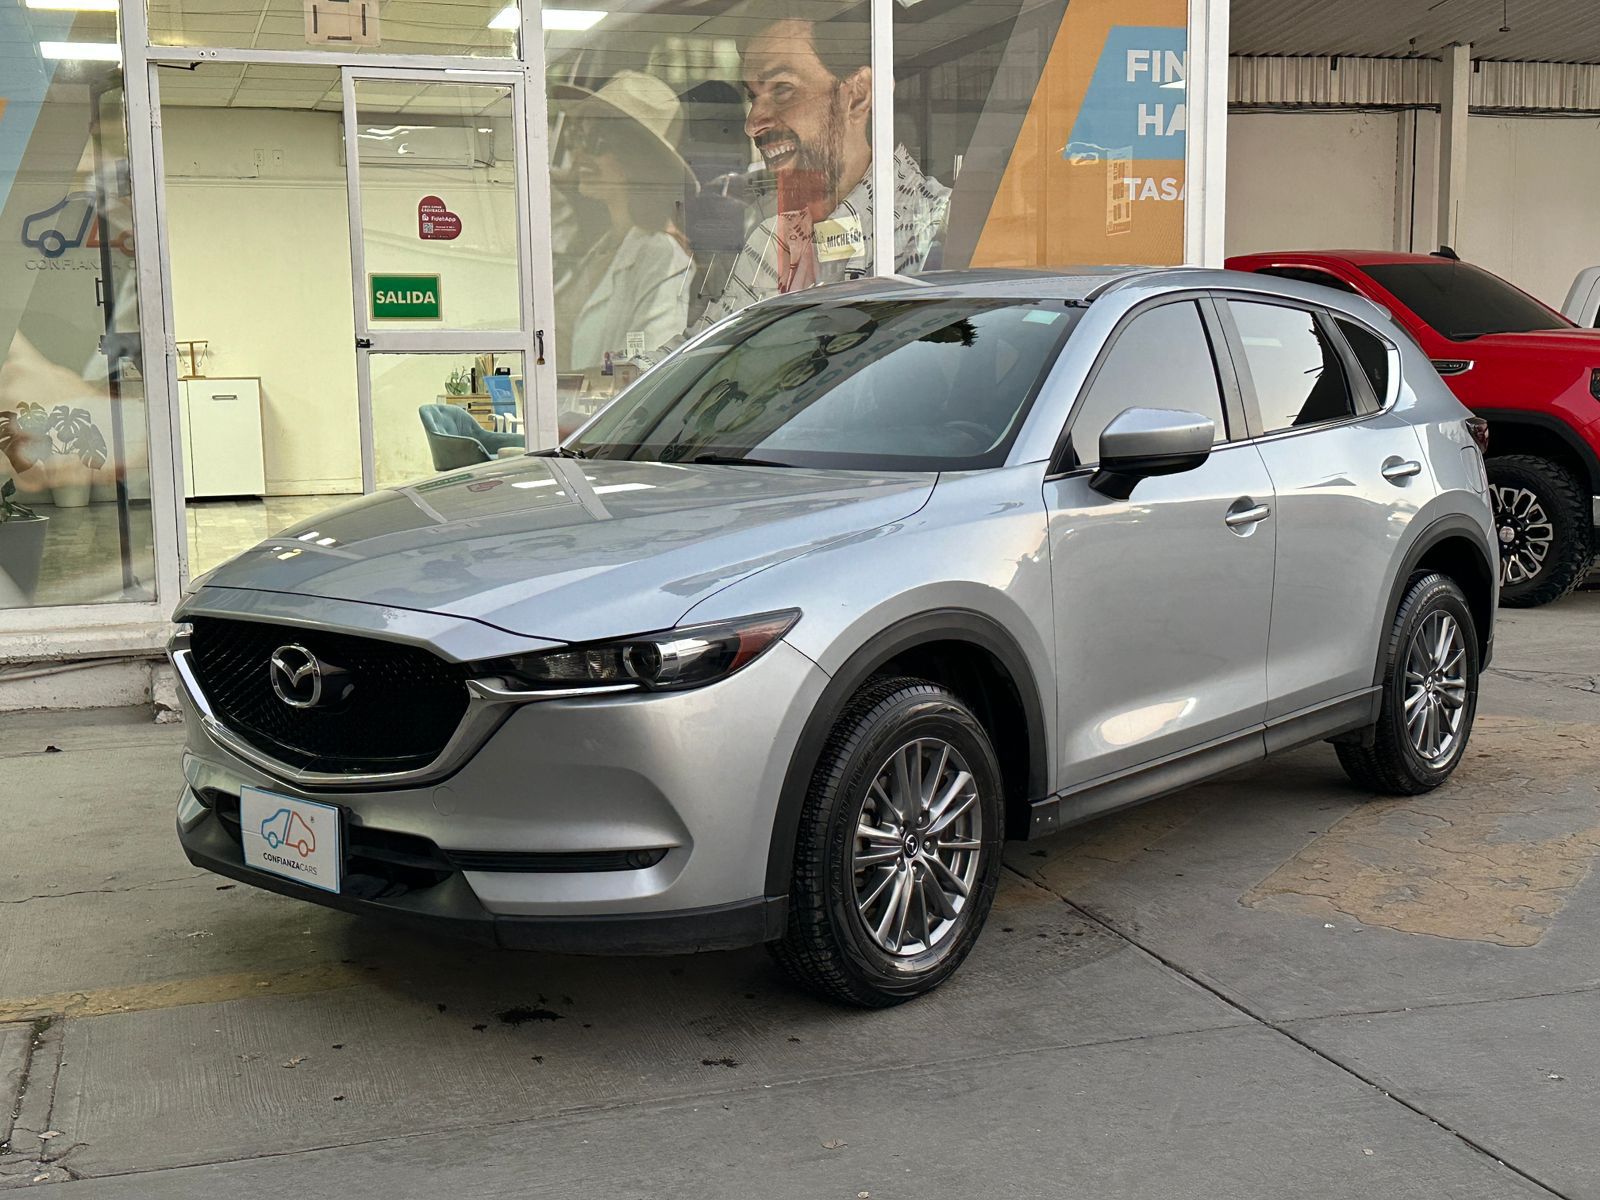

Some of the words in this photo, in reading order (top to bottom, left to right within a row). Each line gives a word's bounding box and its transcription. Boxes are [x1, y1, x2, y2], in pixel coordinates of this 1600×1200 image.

[1122, 177, 1186, 201] TAS
[375, 290, 436, 304] SALIDA
[263, 852, 318, 875] CONFIANZACARS
